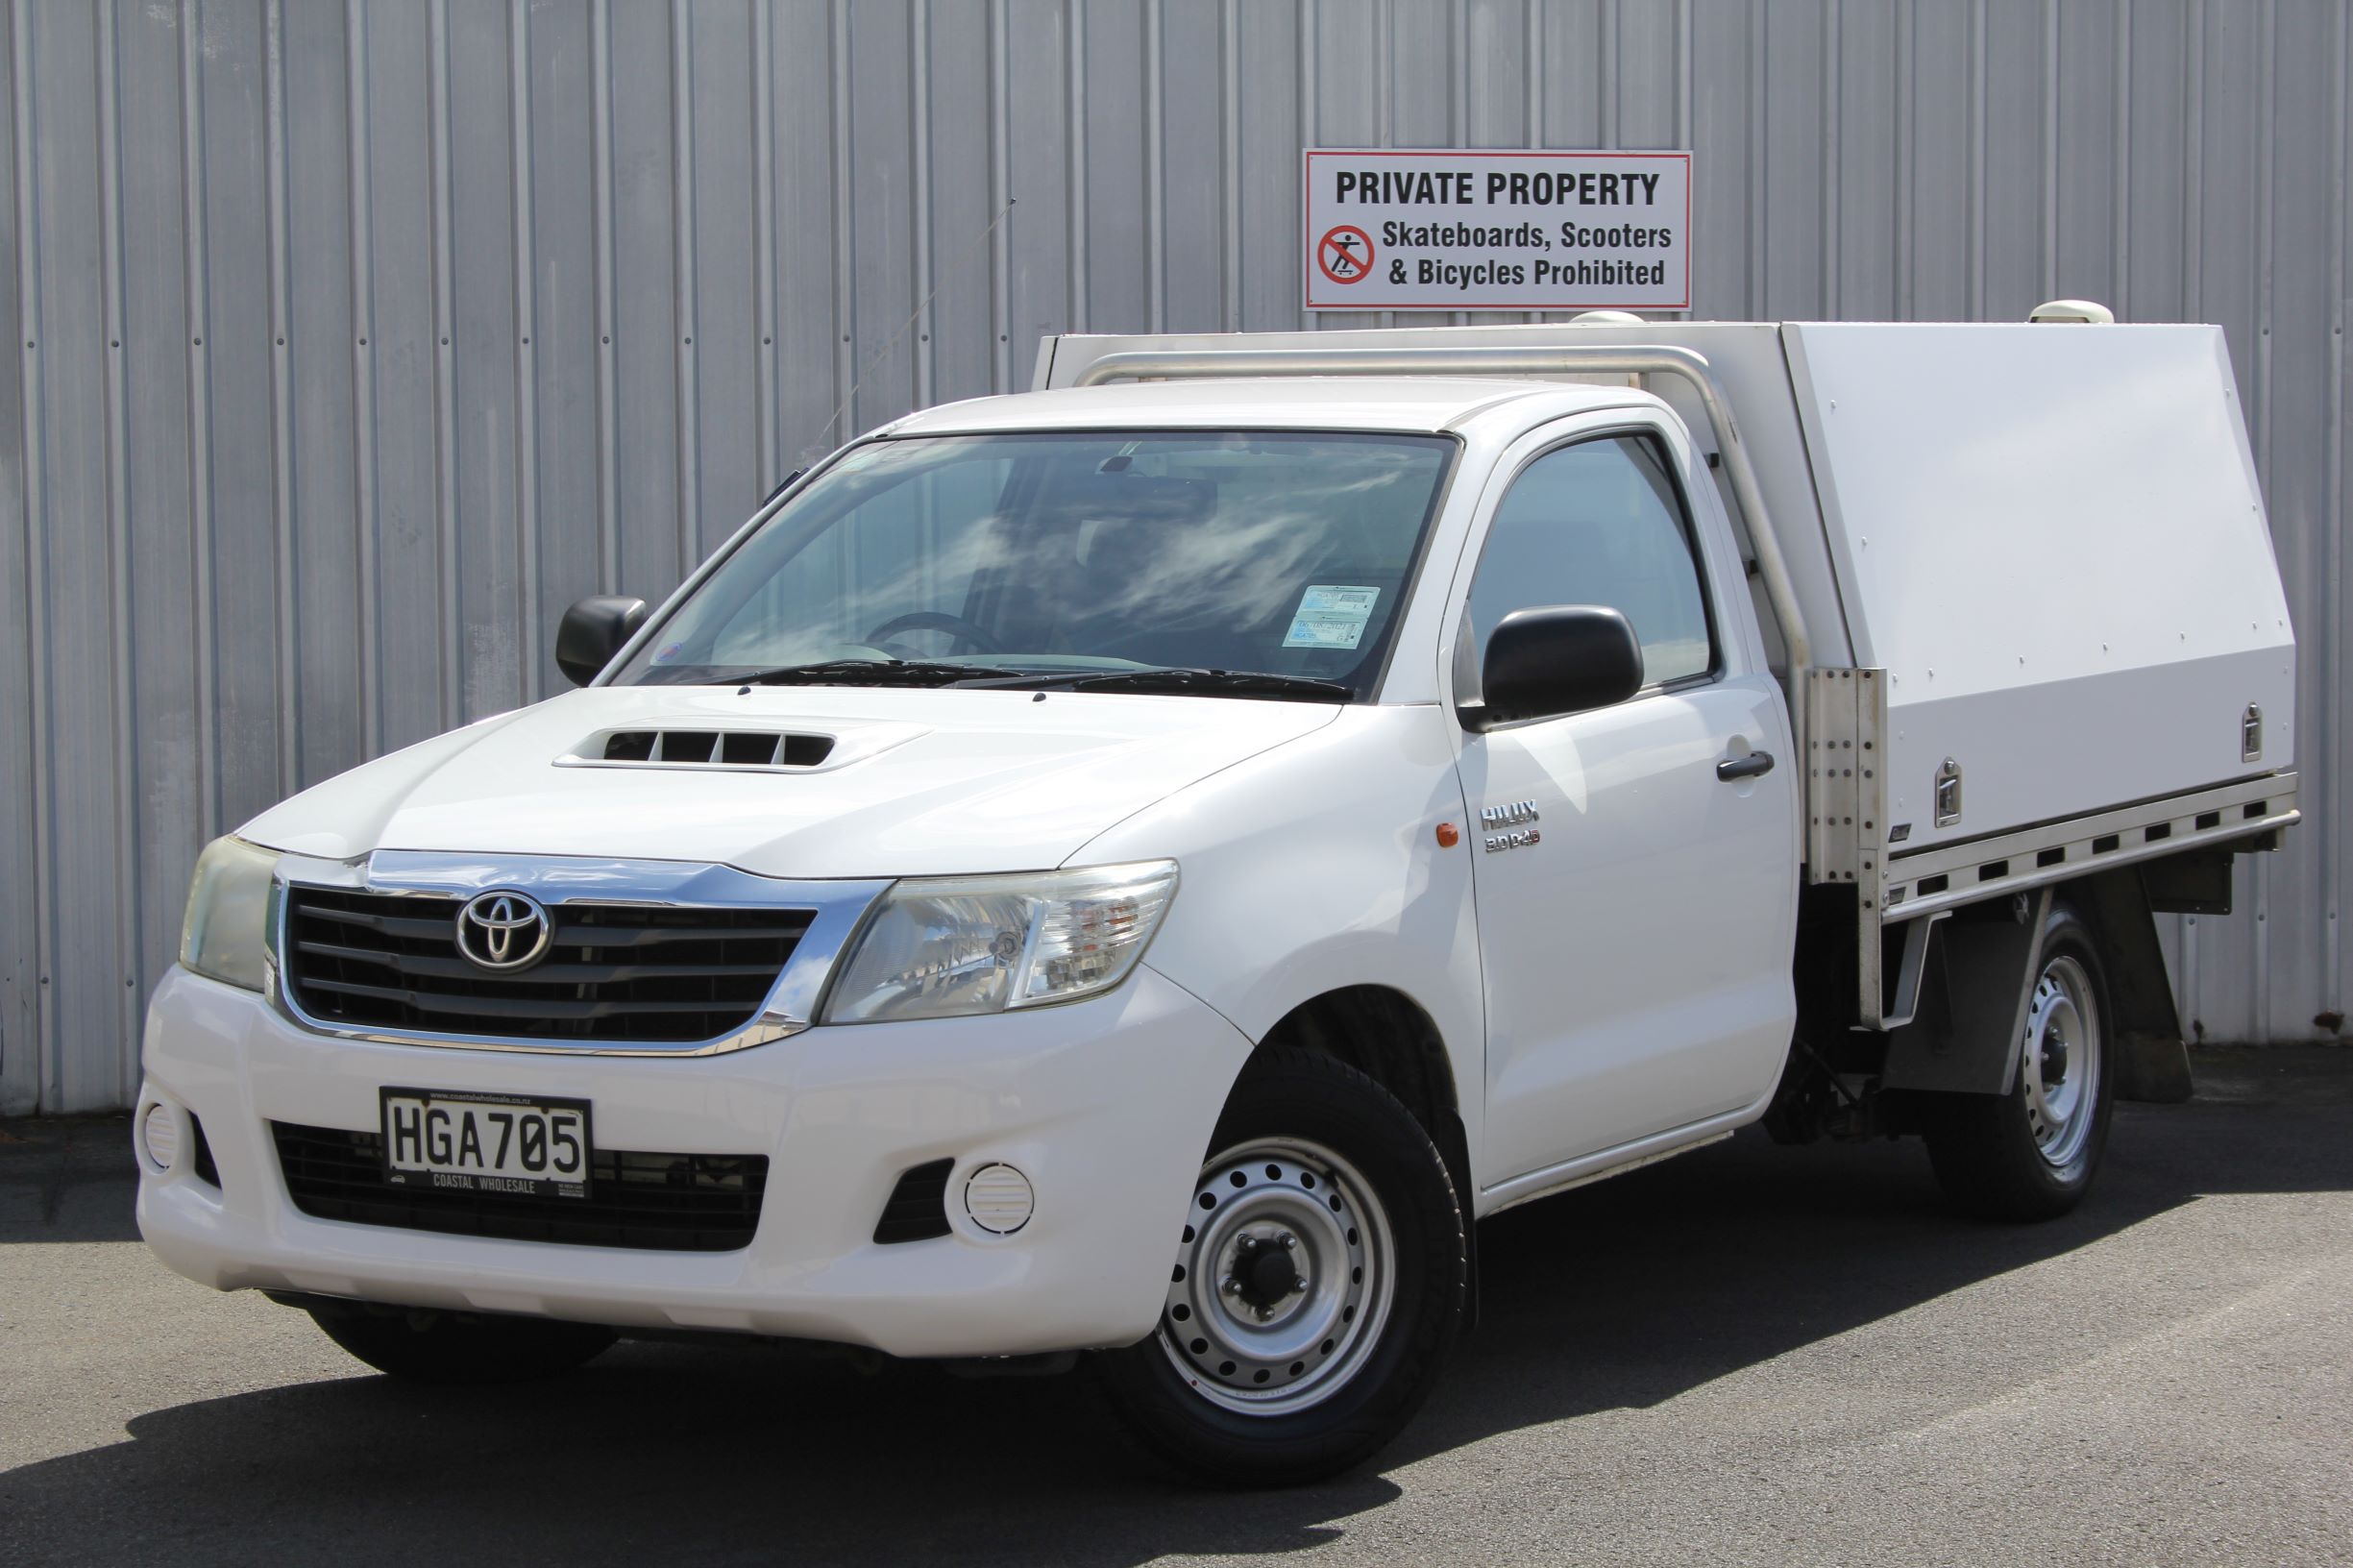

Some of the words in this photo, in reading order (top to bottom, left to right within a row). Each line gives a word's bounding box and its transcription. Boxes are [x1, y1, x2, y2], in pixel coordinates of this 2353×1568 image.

[1336, 171, 1474, 205] PRIVATE
[1486, 172, 1660, 206] PROPERTY
[1382, 220, 1552, 253] Skateboards,
[1560, 221, 1672, 249] Scooters
[1388, 259, 1408, 285] &
[1418, 258, 1525, 290] Bicycles
[1534, 259, 1665, 286] Prohibited
[1480, 798, 1539, 831] HILUX
[429, 1091, 531, 1105] www.coastalwholesale.co.nz
[393, 1106, 580, 1174] HGA705
[433, 1173, 475, 1190] COASTAL
[479, 1177, 536, 1194] WHOLESALE
